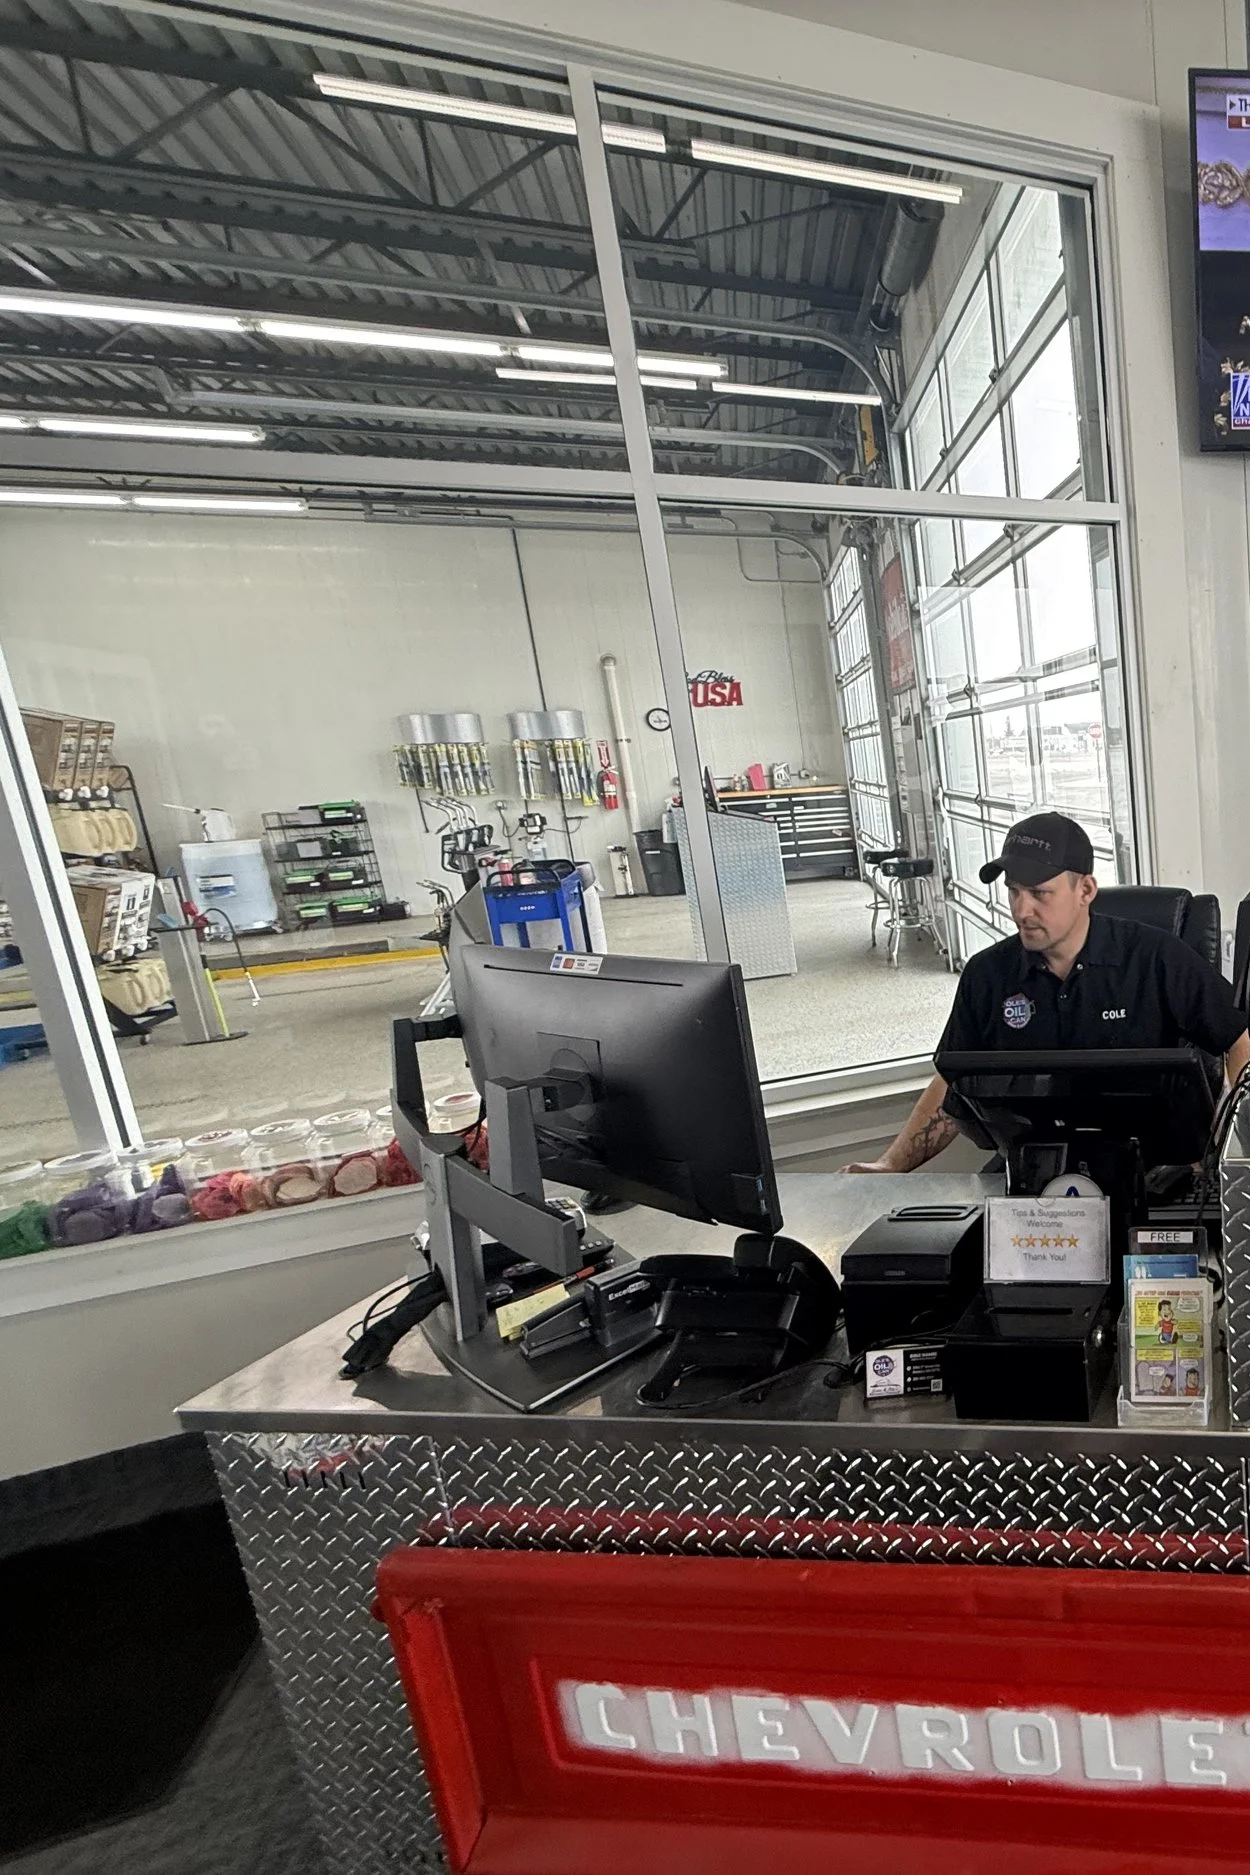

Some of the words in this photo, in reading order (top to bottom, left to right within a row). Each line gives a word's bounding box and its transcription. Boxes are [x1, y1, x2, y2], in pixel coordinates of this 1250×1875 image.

[1004, 1006, 1026, 1017] OIL
[1102, 1008, 1126, 1020] COLE
[1012, 1209, 1028, 1218] Tips
[1037, 1208, 1086, 1219] Suggestions
[1026, 1220, 1063, 1228] Welcome
[1150, 1233, 1181, 1242] FREE
[1023, 1252, 1047, 1261] Thank
[1050, 1253, 1067, 1261] You!
